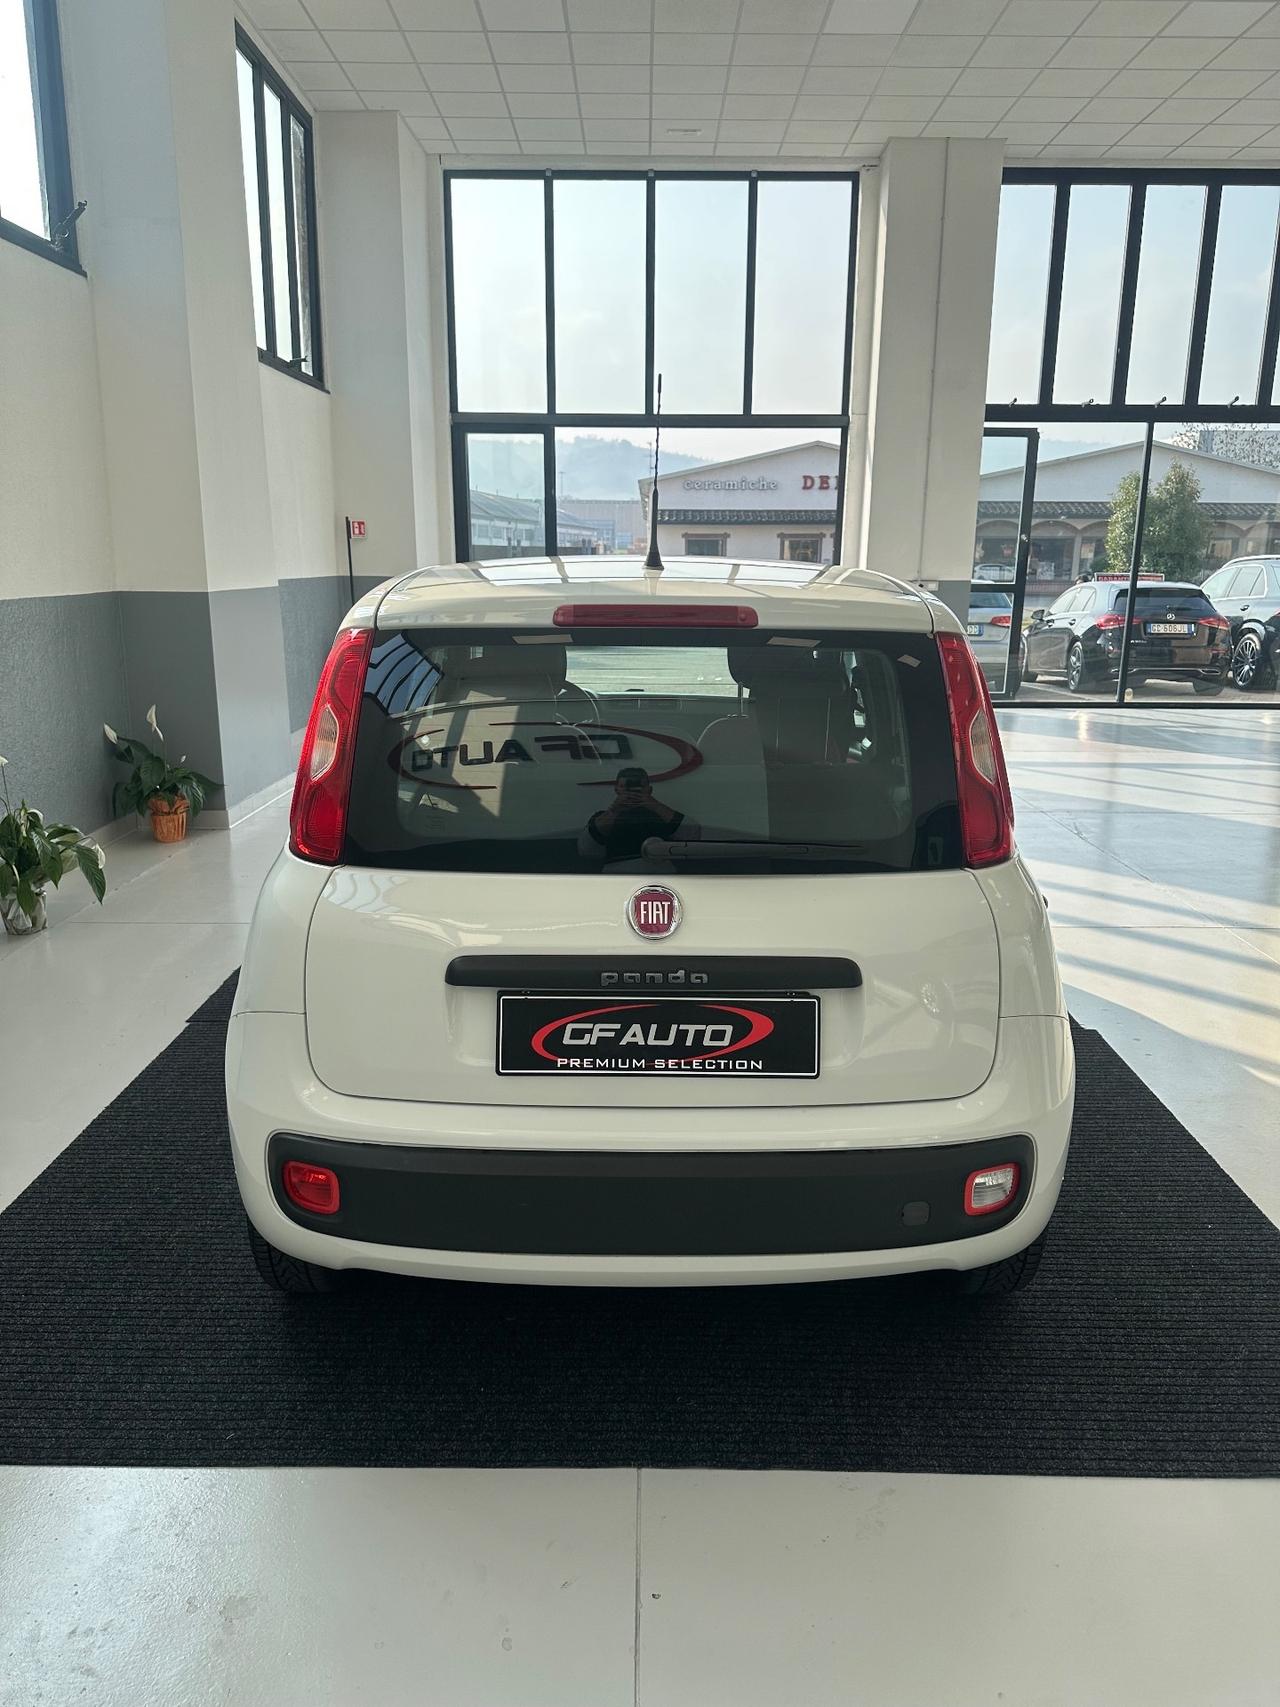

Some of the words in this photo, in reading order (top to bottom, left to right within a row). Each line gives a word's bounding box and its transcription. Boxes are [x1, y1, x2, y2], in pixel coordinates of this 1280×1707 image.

[683, 476, 778, 490] ceramiche
[640, 901, 671, 924] FIAT
[601, 969, 708, 986] panda
[557, 1058, 646, 1069] PREMIUM
[654, 1059, 763, 1070] SELECTION
